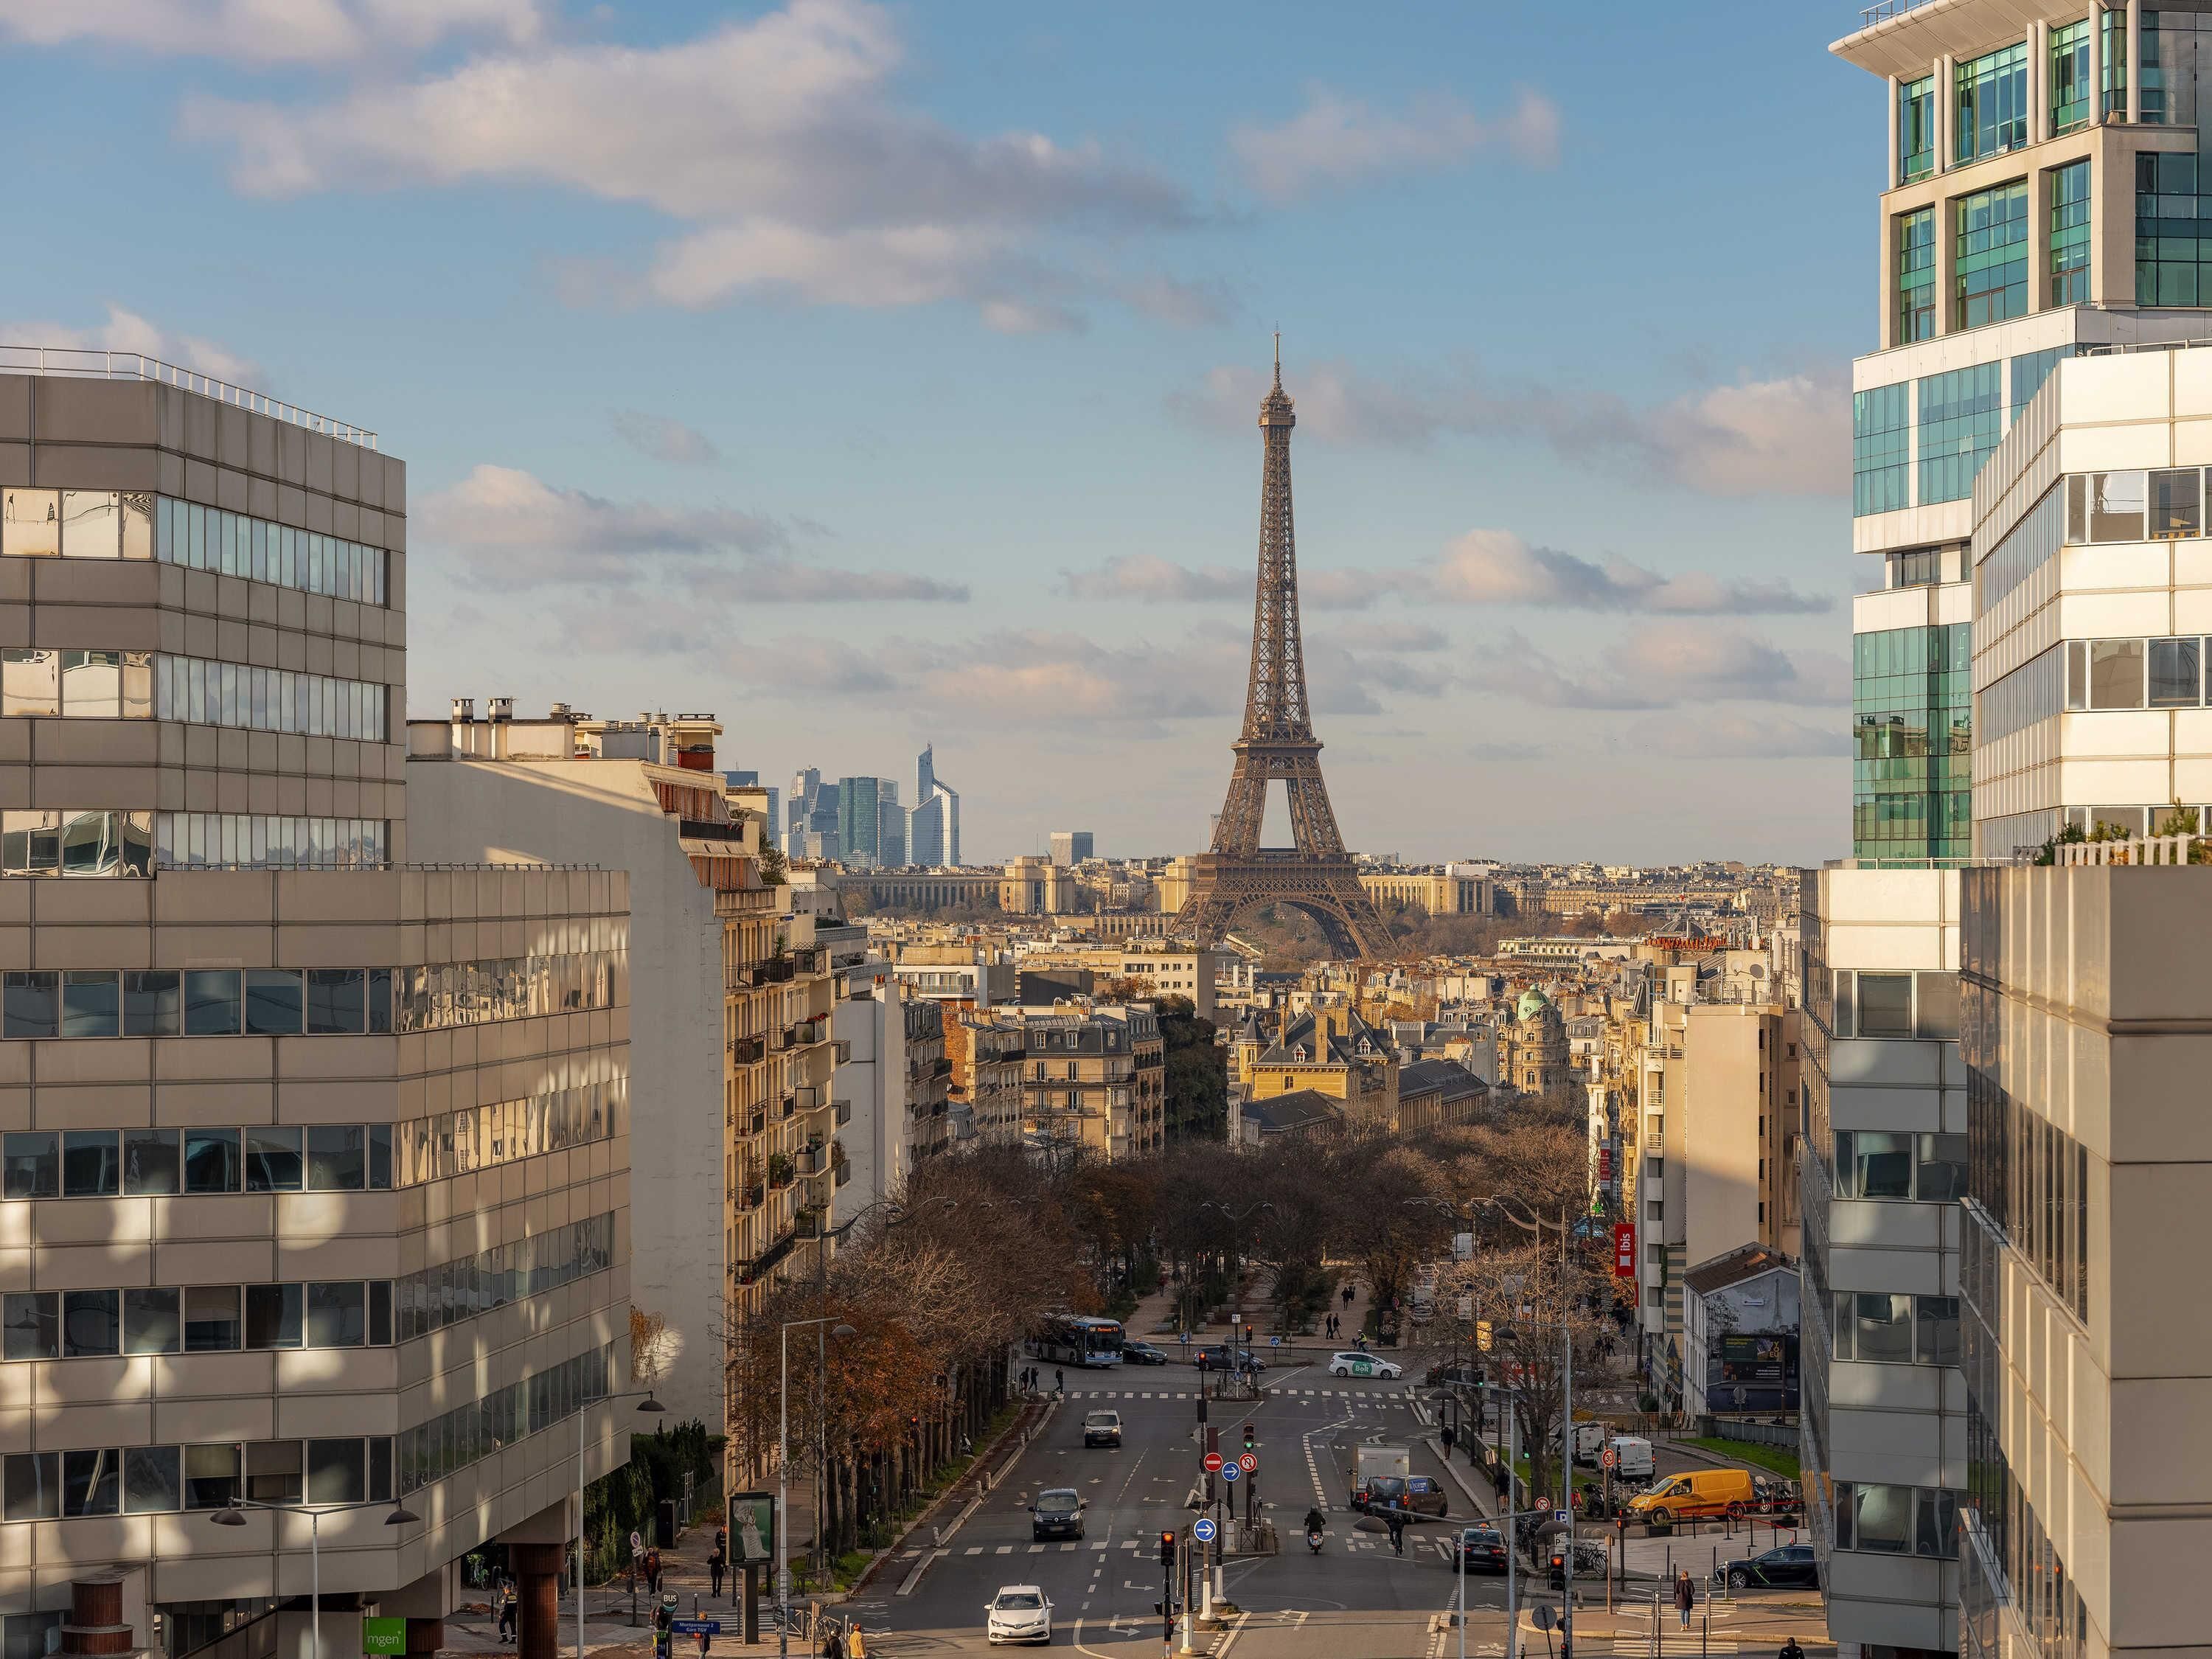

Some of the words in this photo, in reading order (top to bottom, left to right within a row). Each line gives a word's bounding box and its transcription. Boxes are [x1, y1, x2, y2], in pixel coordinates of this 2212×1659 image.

[1620, 1233, 1631, 1251] ibis
[1355, 1363, 1369, 1372] Bolt
[367, 1635, 399, 1647] mgen
